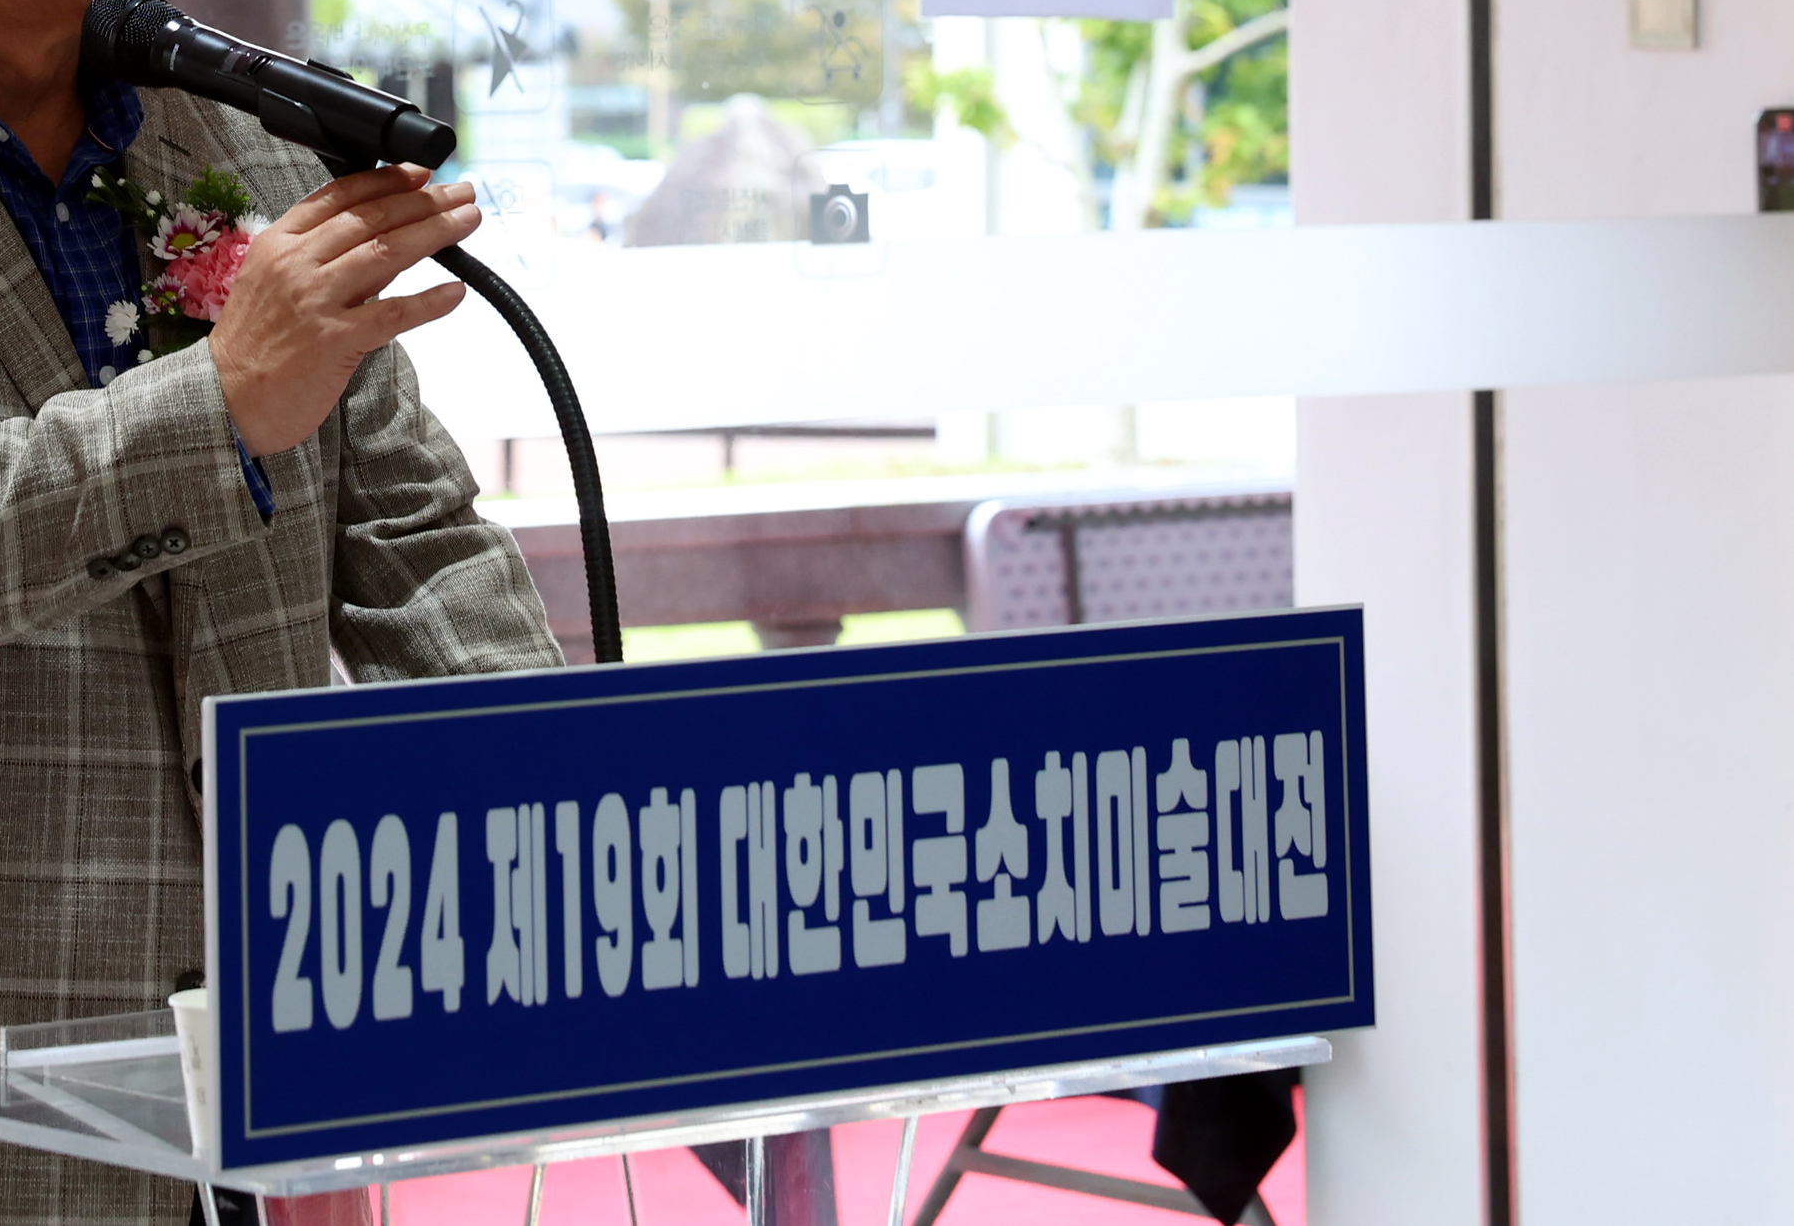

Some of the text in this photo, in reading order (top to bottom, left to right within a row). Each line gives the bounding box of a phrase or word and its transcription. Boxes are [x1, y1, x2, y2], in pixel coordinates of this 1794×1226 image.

[271, 731, 1329, 1031] 2024 제19회 대한민국소치미술대전
